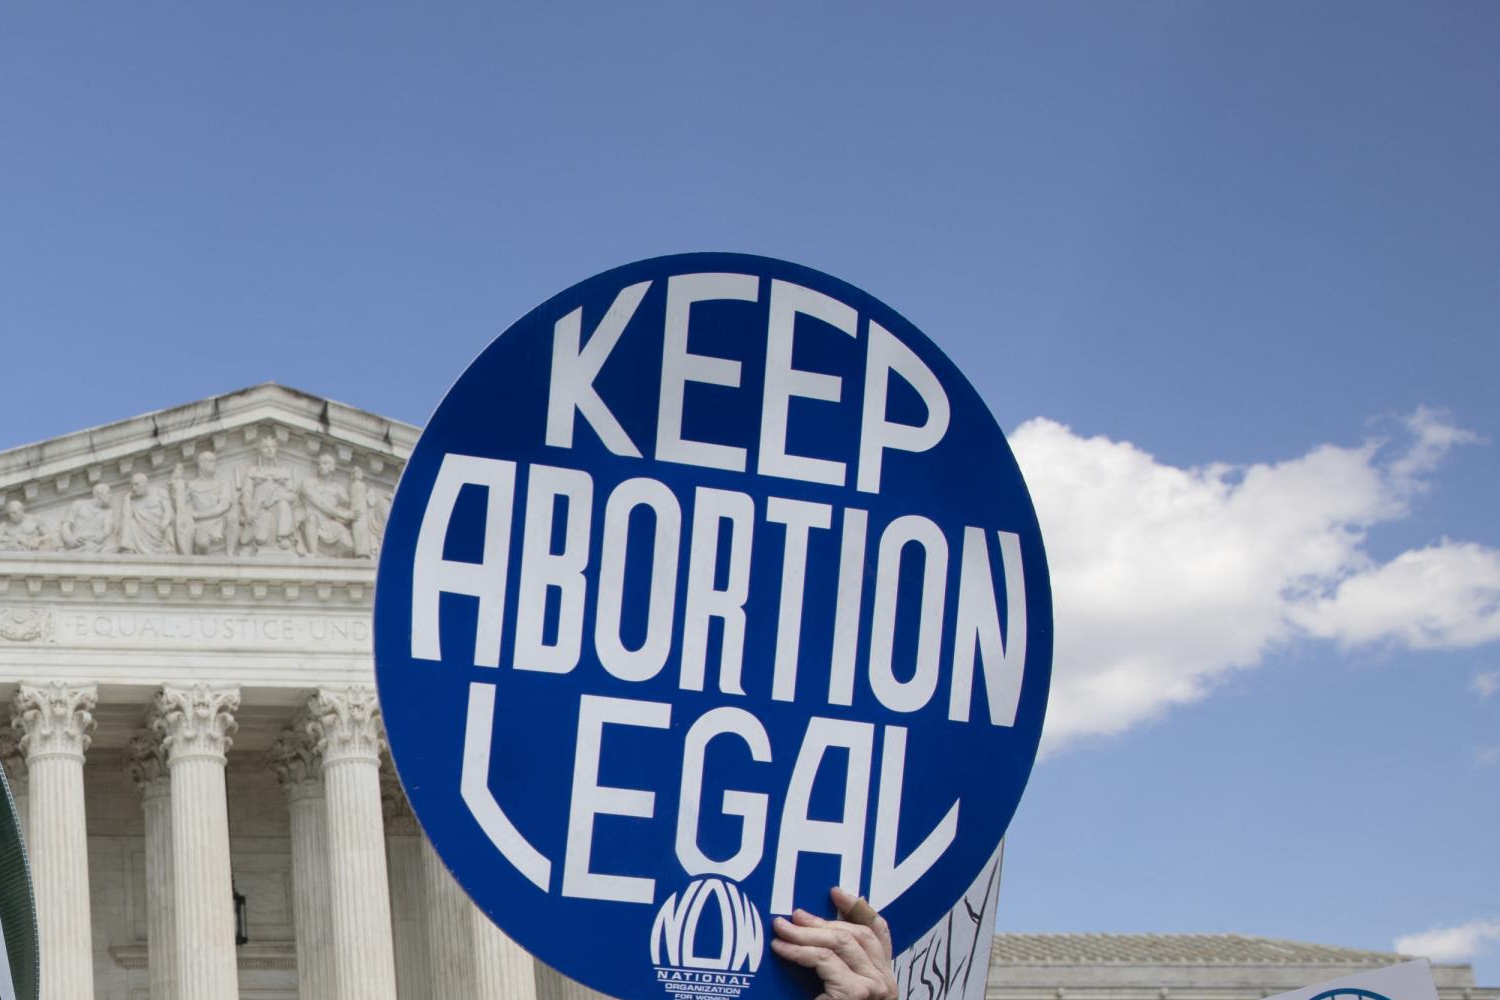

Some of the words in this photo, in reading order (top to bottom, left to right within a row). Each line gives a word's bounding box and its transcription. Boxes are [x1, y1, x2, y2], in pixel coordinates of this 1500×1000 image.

[545, 271, 951, 493] KEEP
[410, 452, 1028, 728] ABORTION
[75, 615, 174, 639] EQUAL
[182, 618, 295, 641] JUSTICE
[308, 619, 369, 643] UND
[460, 682, 961, 916] LEGAL
[650, 878, 764, 973] NOW
[657, 970, 751, 986] NATIONAL
[664, 982, 741, 995] ORGANIZATION
[674, 993, 693, 1000] FOR
